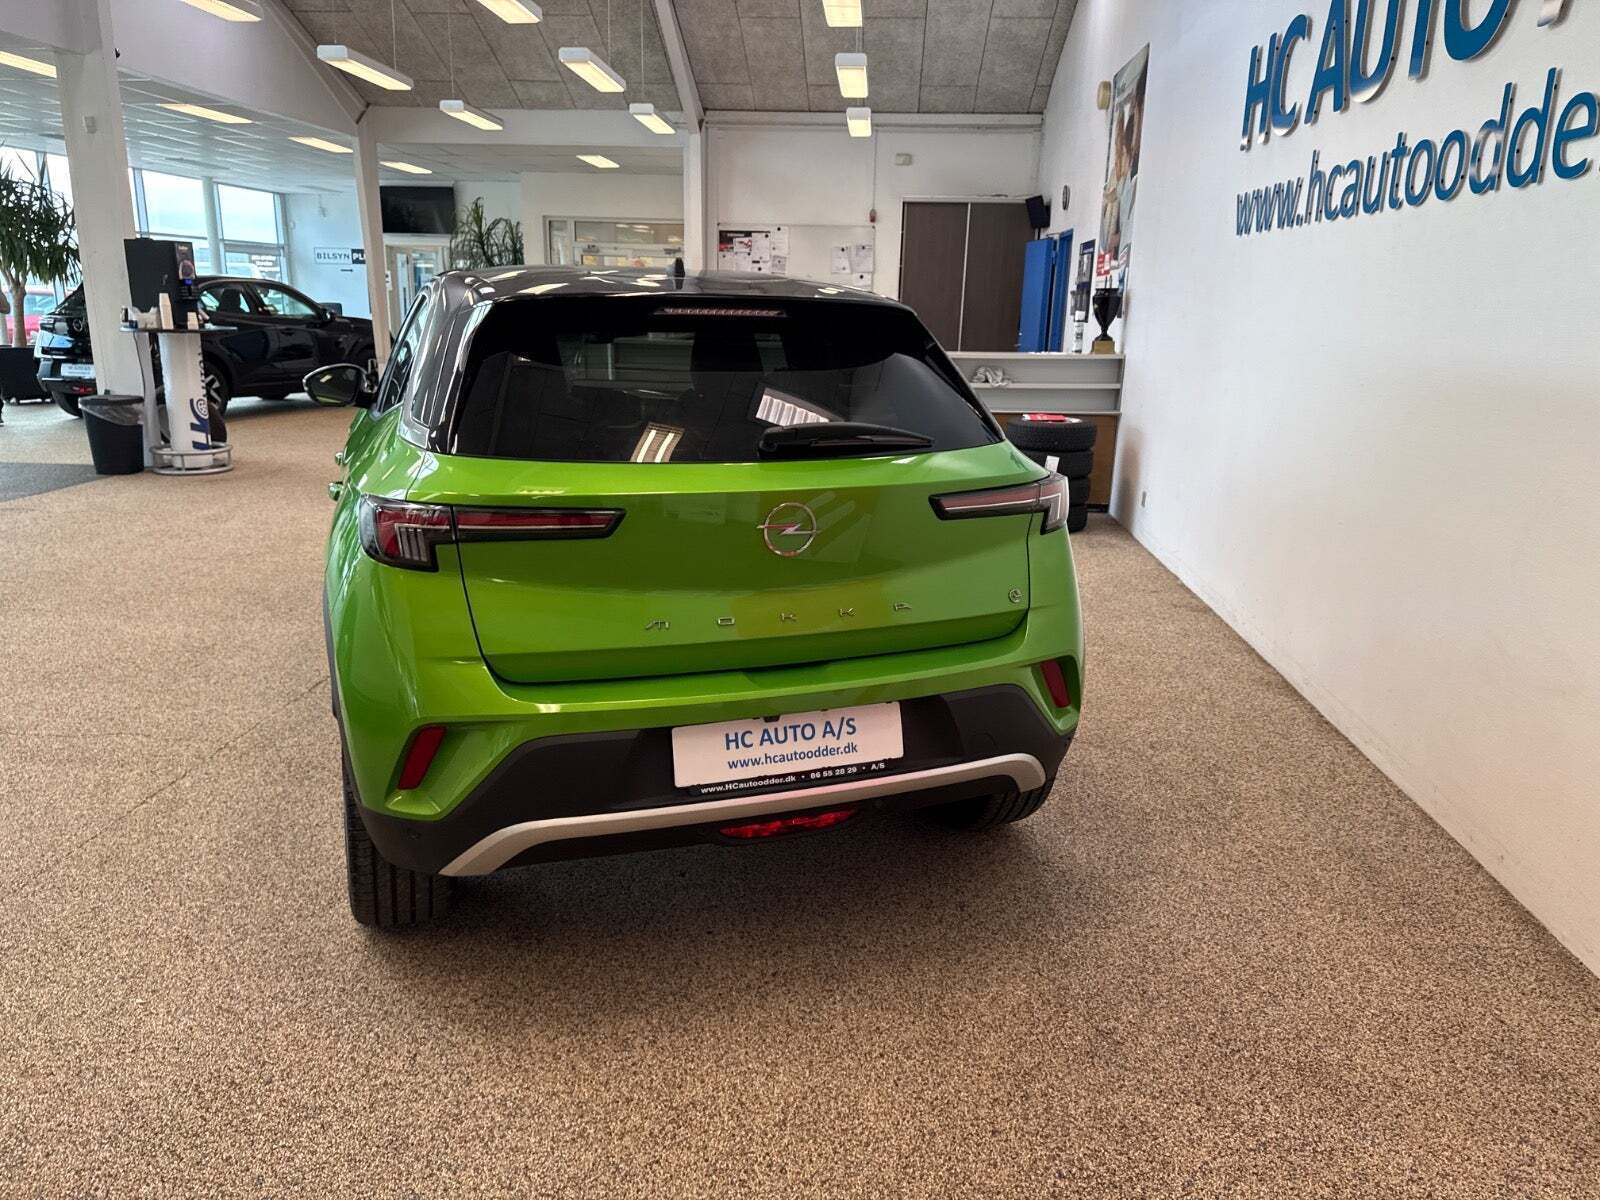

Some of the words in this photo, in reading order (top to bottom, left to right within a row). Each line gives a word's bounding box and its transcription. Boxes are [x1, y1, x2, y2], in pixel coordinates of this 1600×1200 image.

[1240, 14, 1309, 150] HC
[1236, 67, 1600, 236] www.hcautoodde
[316, 252, 350, 260] BILSYN
[725, 730, 754, 751] HC
[759, 723, 816, 747] AUTO
[822, 716, 857, 741] A/S
[727, 742, 858, 768] www.hcautoodder.dk
[700, 775, 796, 794] www.HCautoodder.dk
[871, 762, 885, 770] A/S
